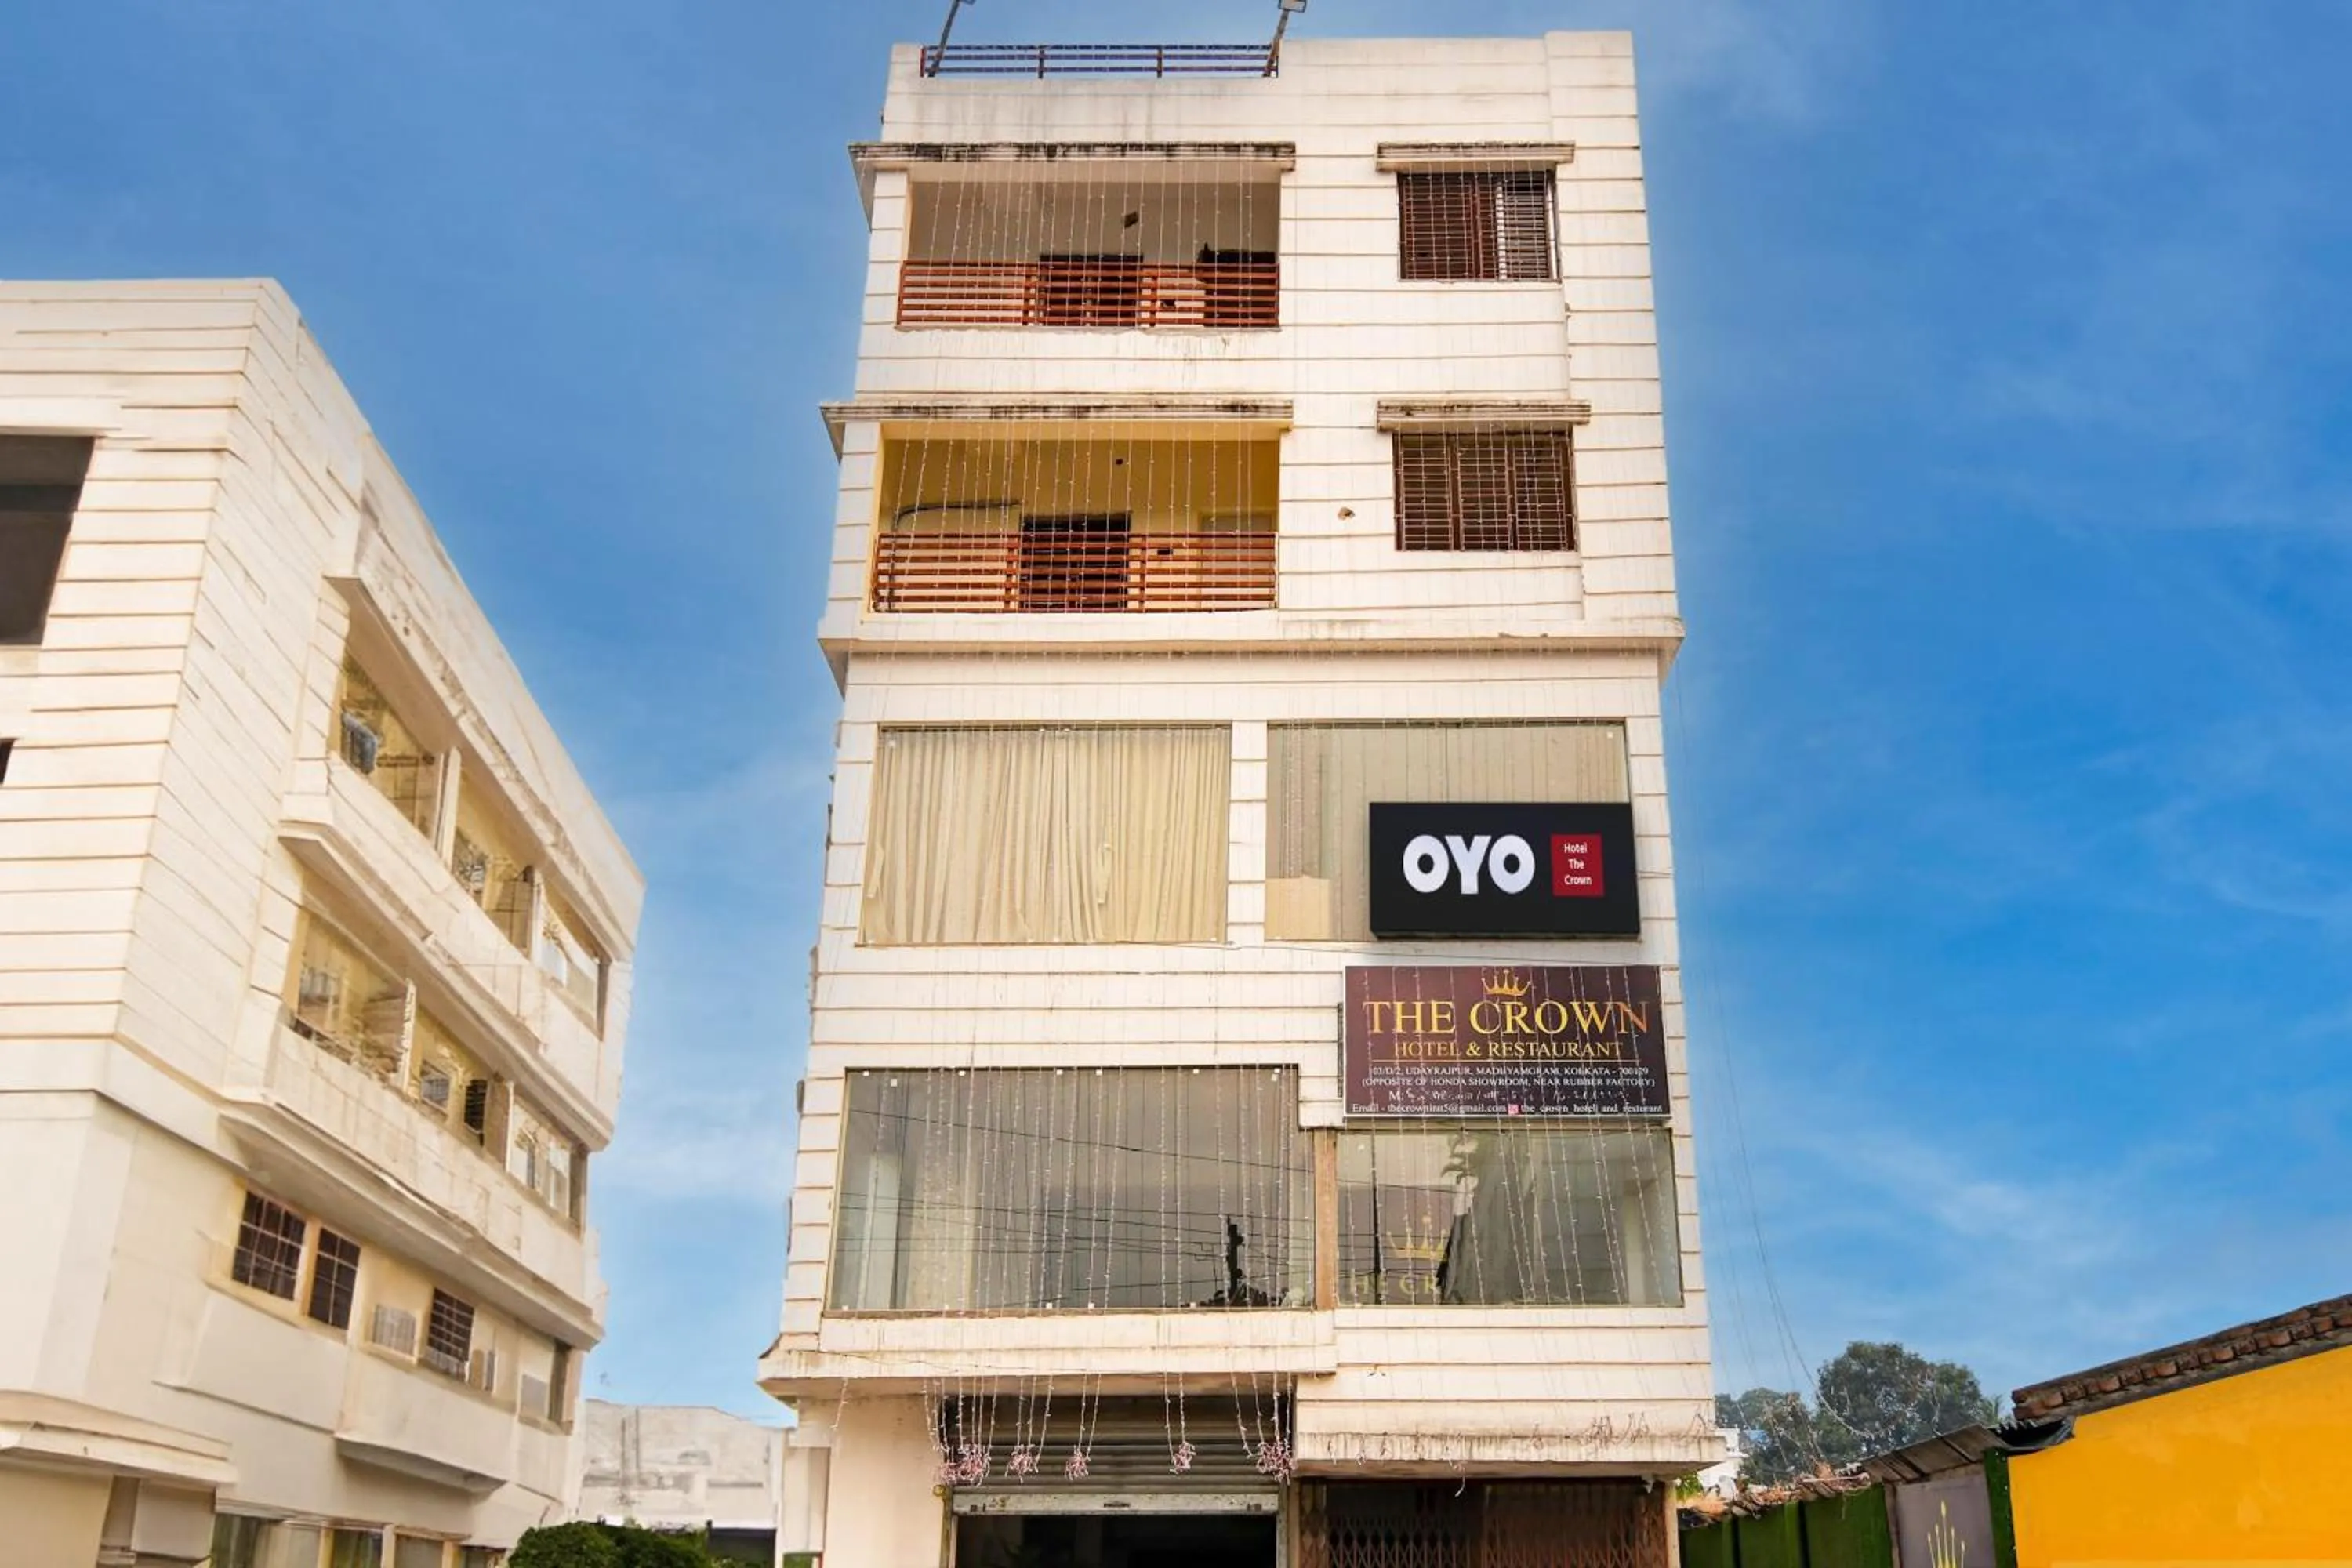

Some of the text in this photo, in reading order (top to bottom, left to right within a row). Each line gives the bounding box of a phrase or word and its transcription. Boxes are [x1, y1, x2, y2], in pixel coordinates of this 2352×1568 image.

[1564, 842, 1588, 854] Hotel
[1403, 835, 1535, 894] OYO
[1568, 859, 1584, 870] The
[1564, 875, 1592, 886] Crown
[1363, 1000, 1650, 1035] THE CROWN
[1395, 1041, 1624, 1057] HOTEL & RESTAURANT
[1564, 1067, 1610, 1076] KOLKATA
[1431, 1077, 1466, 1087] HONDA
[1534, 1078, 1561, 1087] NEAR
[1563, 1078, 1603, 1087] RUBBER
[1352, 1103, 1379, 1112] Email
[1601, 1103, 1618, 1112] and
